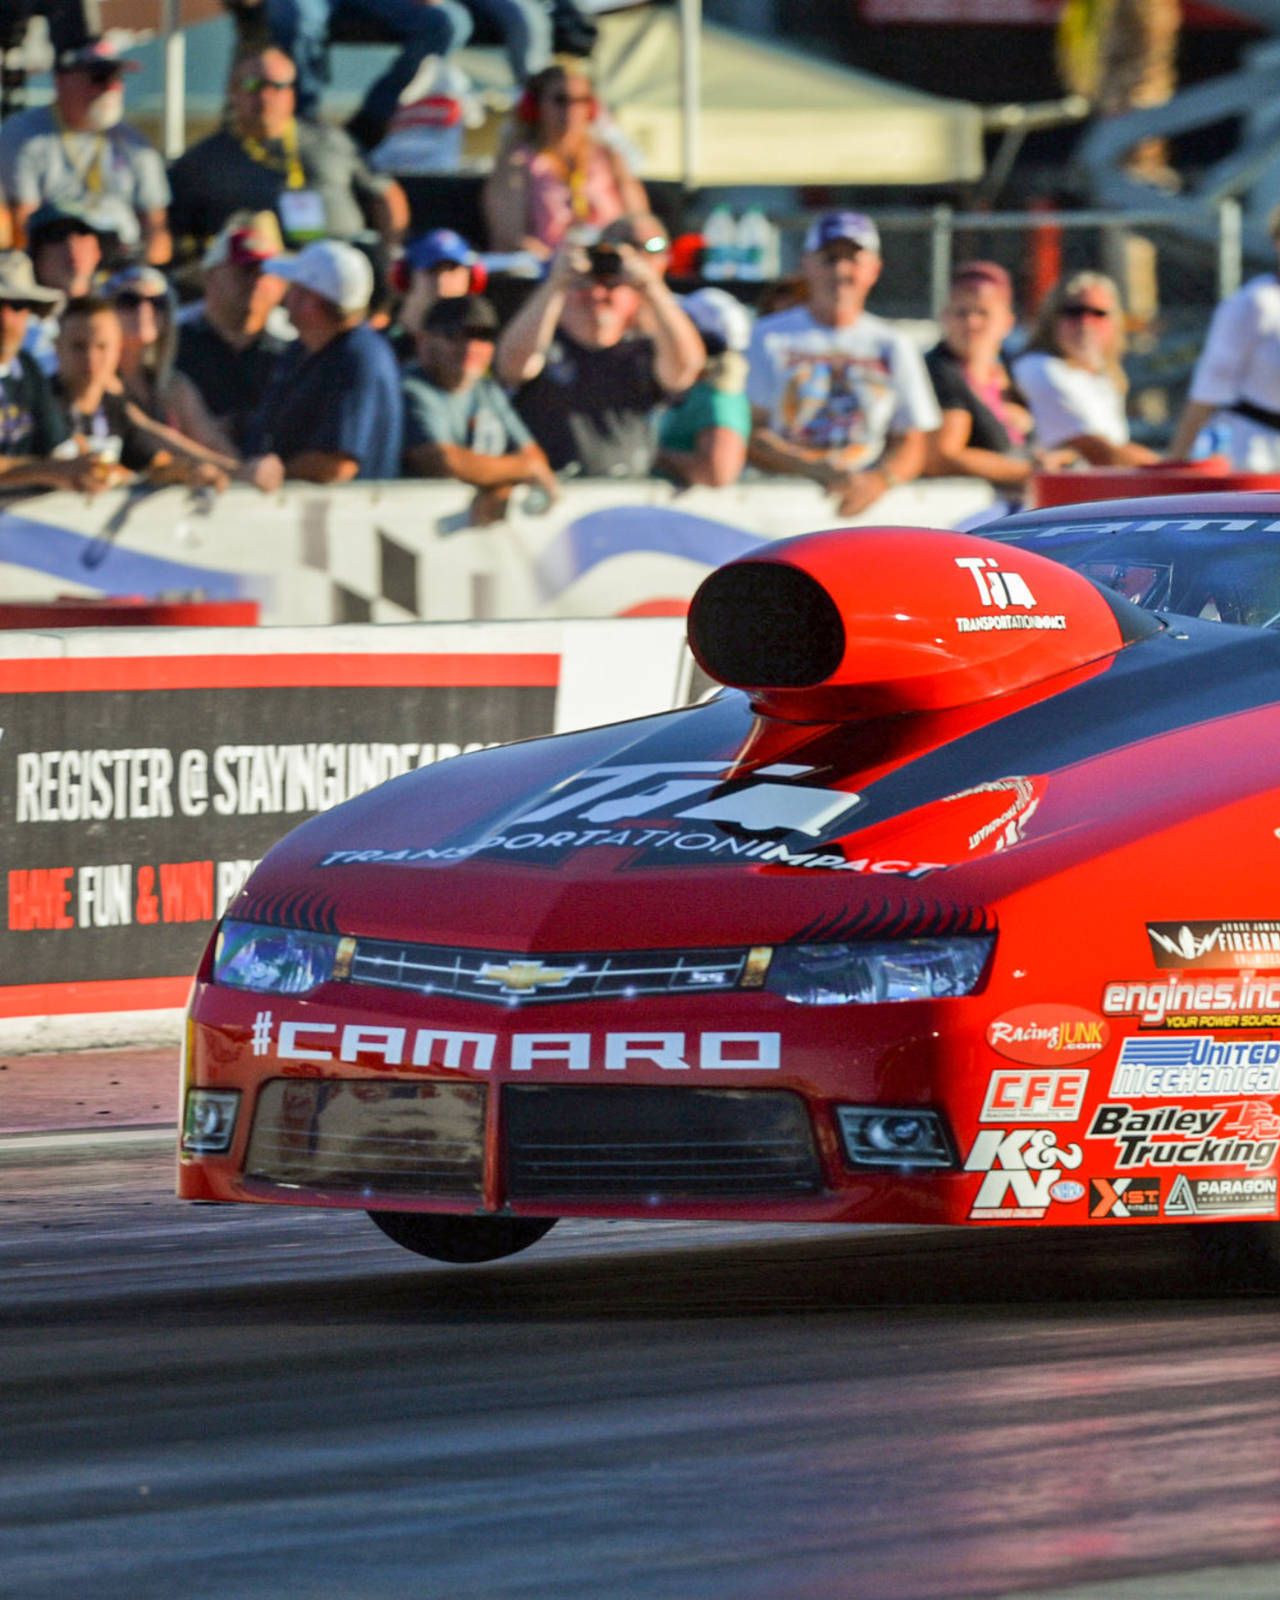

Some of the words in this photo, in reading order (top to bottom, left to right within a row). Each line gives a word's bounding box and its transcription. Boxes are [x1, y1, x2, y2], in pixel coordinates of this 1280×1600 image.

[17, 748, 173, 821] REGISTER
[179, 750, 208, 816] @
[8, 867, 73, 930] HAVE
[78, 864, 132, 927] FUN
[136, 865, 158, 924] &
[159, 860, 213, 922] WIN
[1166, 1017, 1197, 1028] YOUR
[1199, 1016, 1239, 1027] POWER
[251, 1012, 781, 1070] #CAMARO
[991, 1076, 1081, 1109] CFE
[1091, 1107, 1222, 1136] Bailey
[1118, 1136, 1276, 1167] Trucking
[1197, 1180, 1276, 1194] PARAGON
